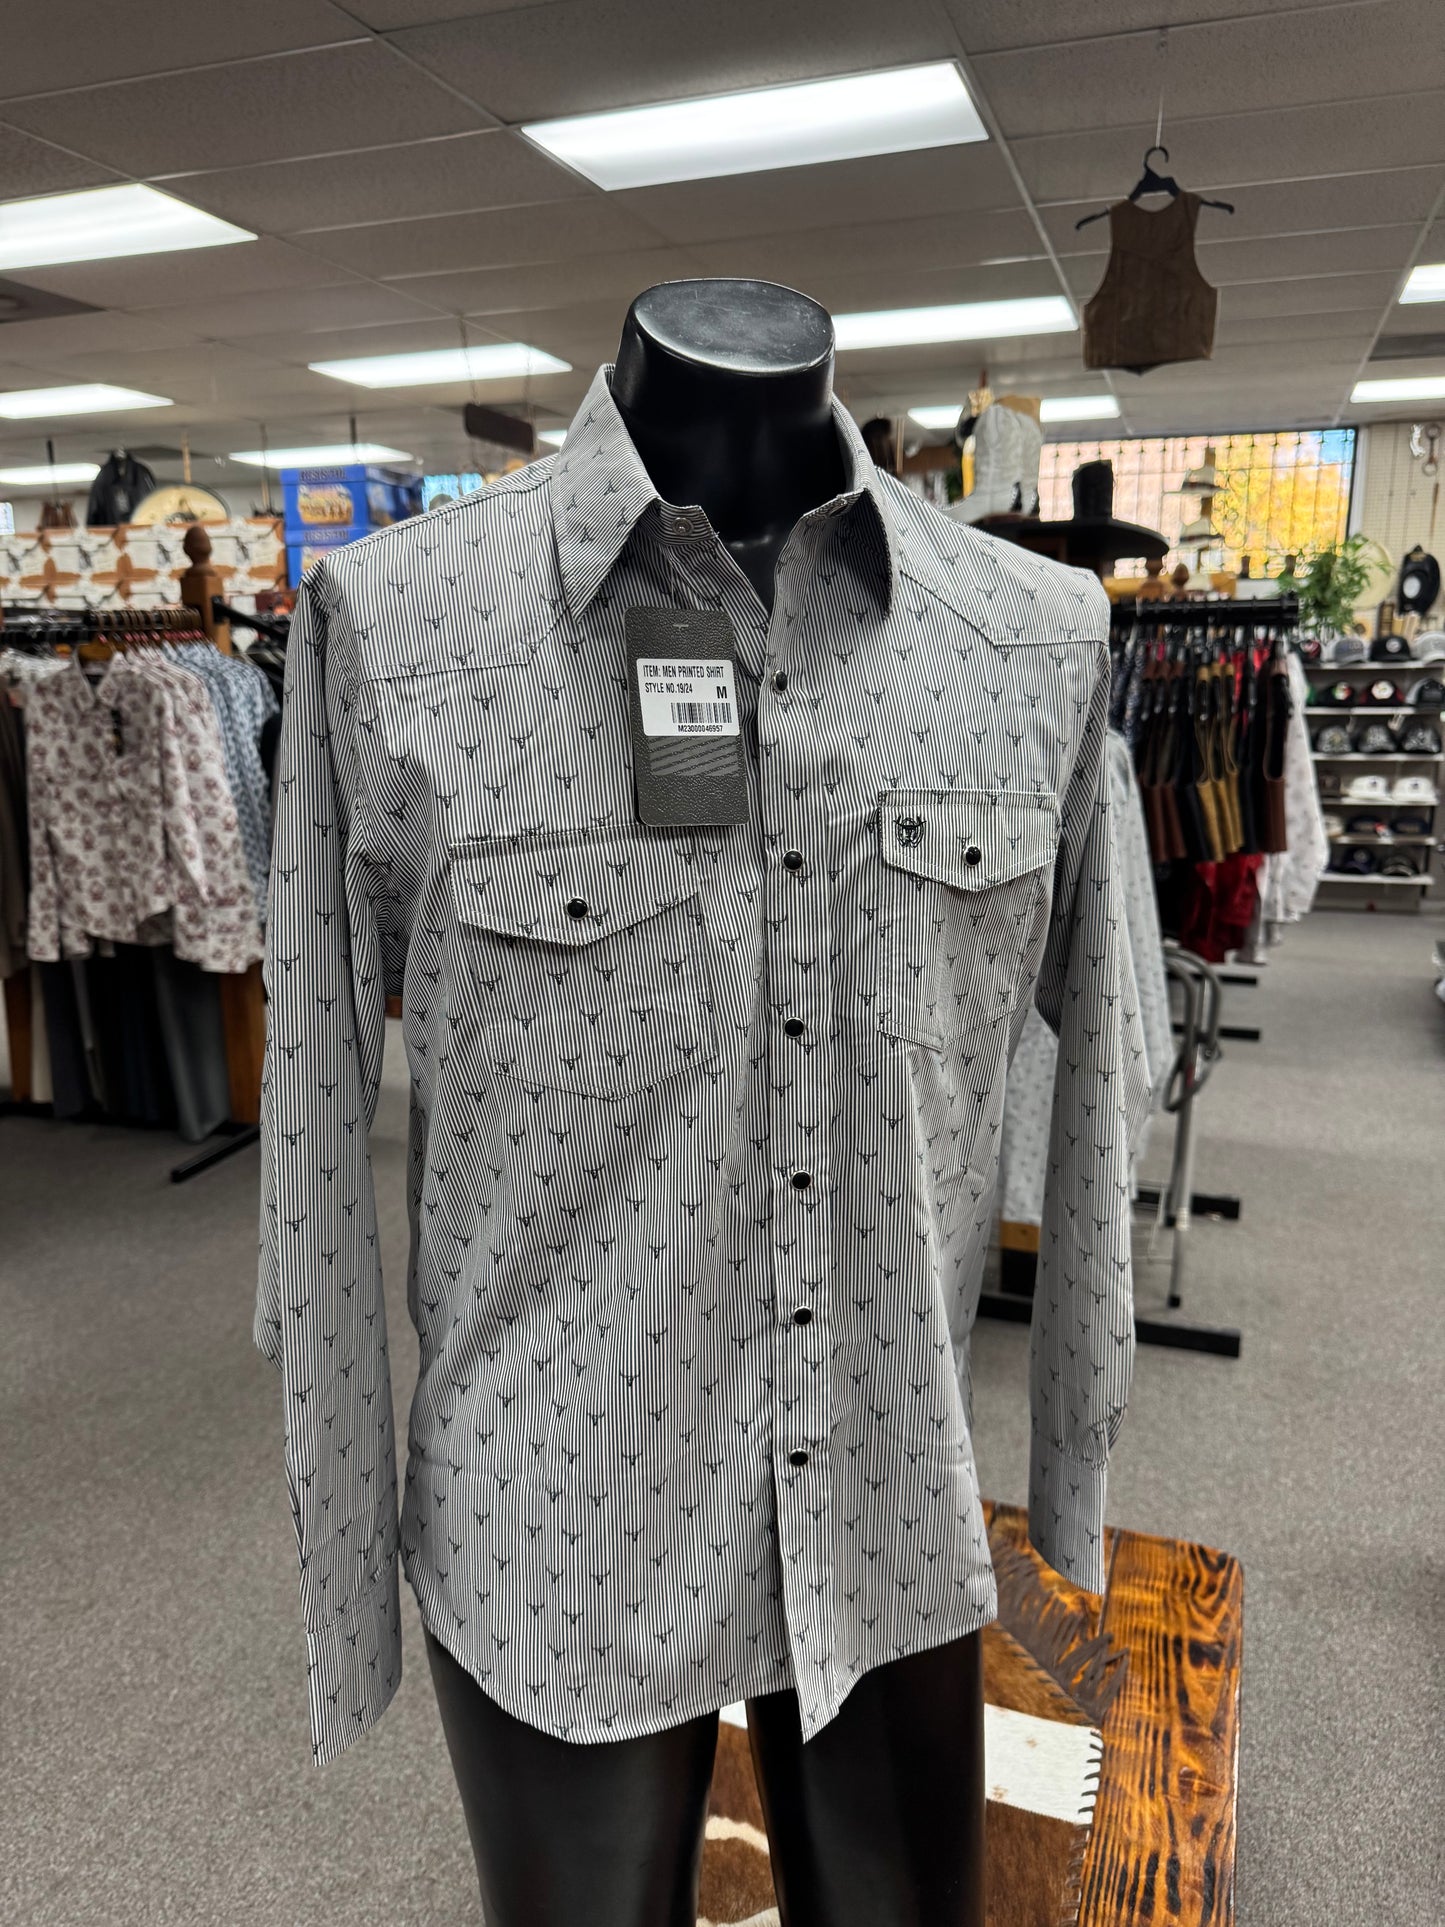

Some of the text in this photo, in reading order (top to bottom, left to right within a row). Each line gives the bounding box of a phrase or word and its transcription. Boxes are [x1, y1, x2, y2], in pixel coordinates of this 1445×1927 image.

[643, 665, 724, 678] ITEM: MEN PRINTED SHIRT
[645, 683, 664, 693] STYLE
[716, 686, 728, 698] M
